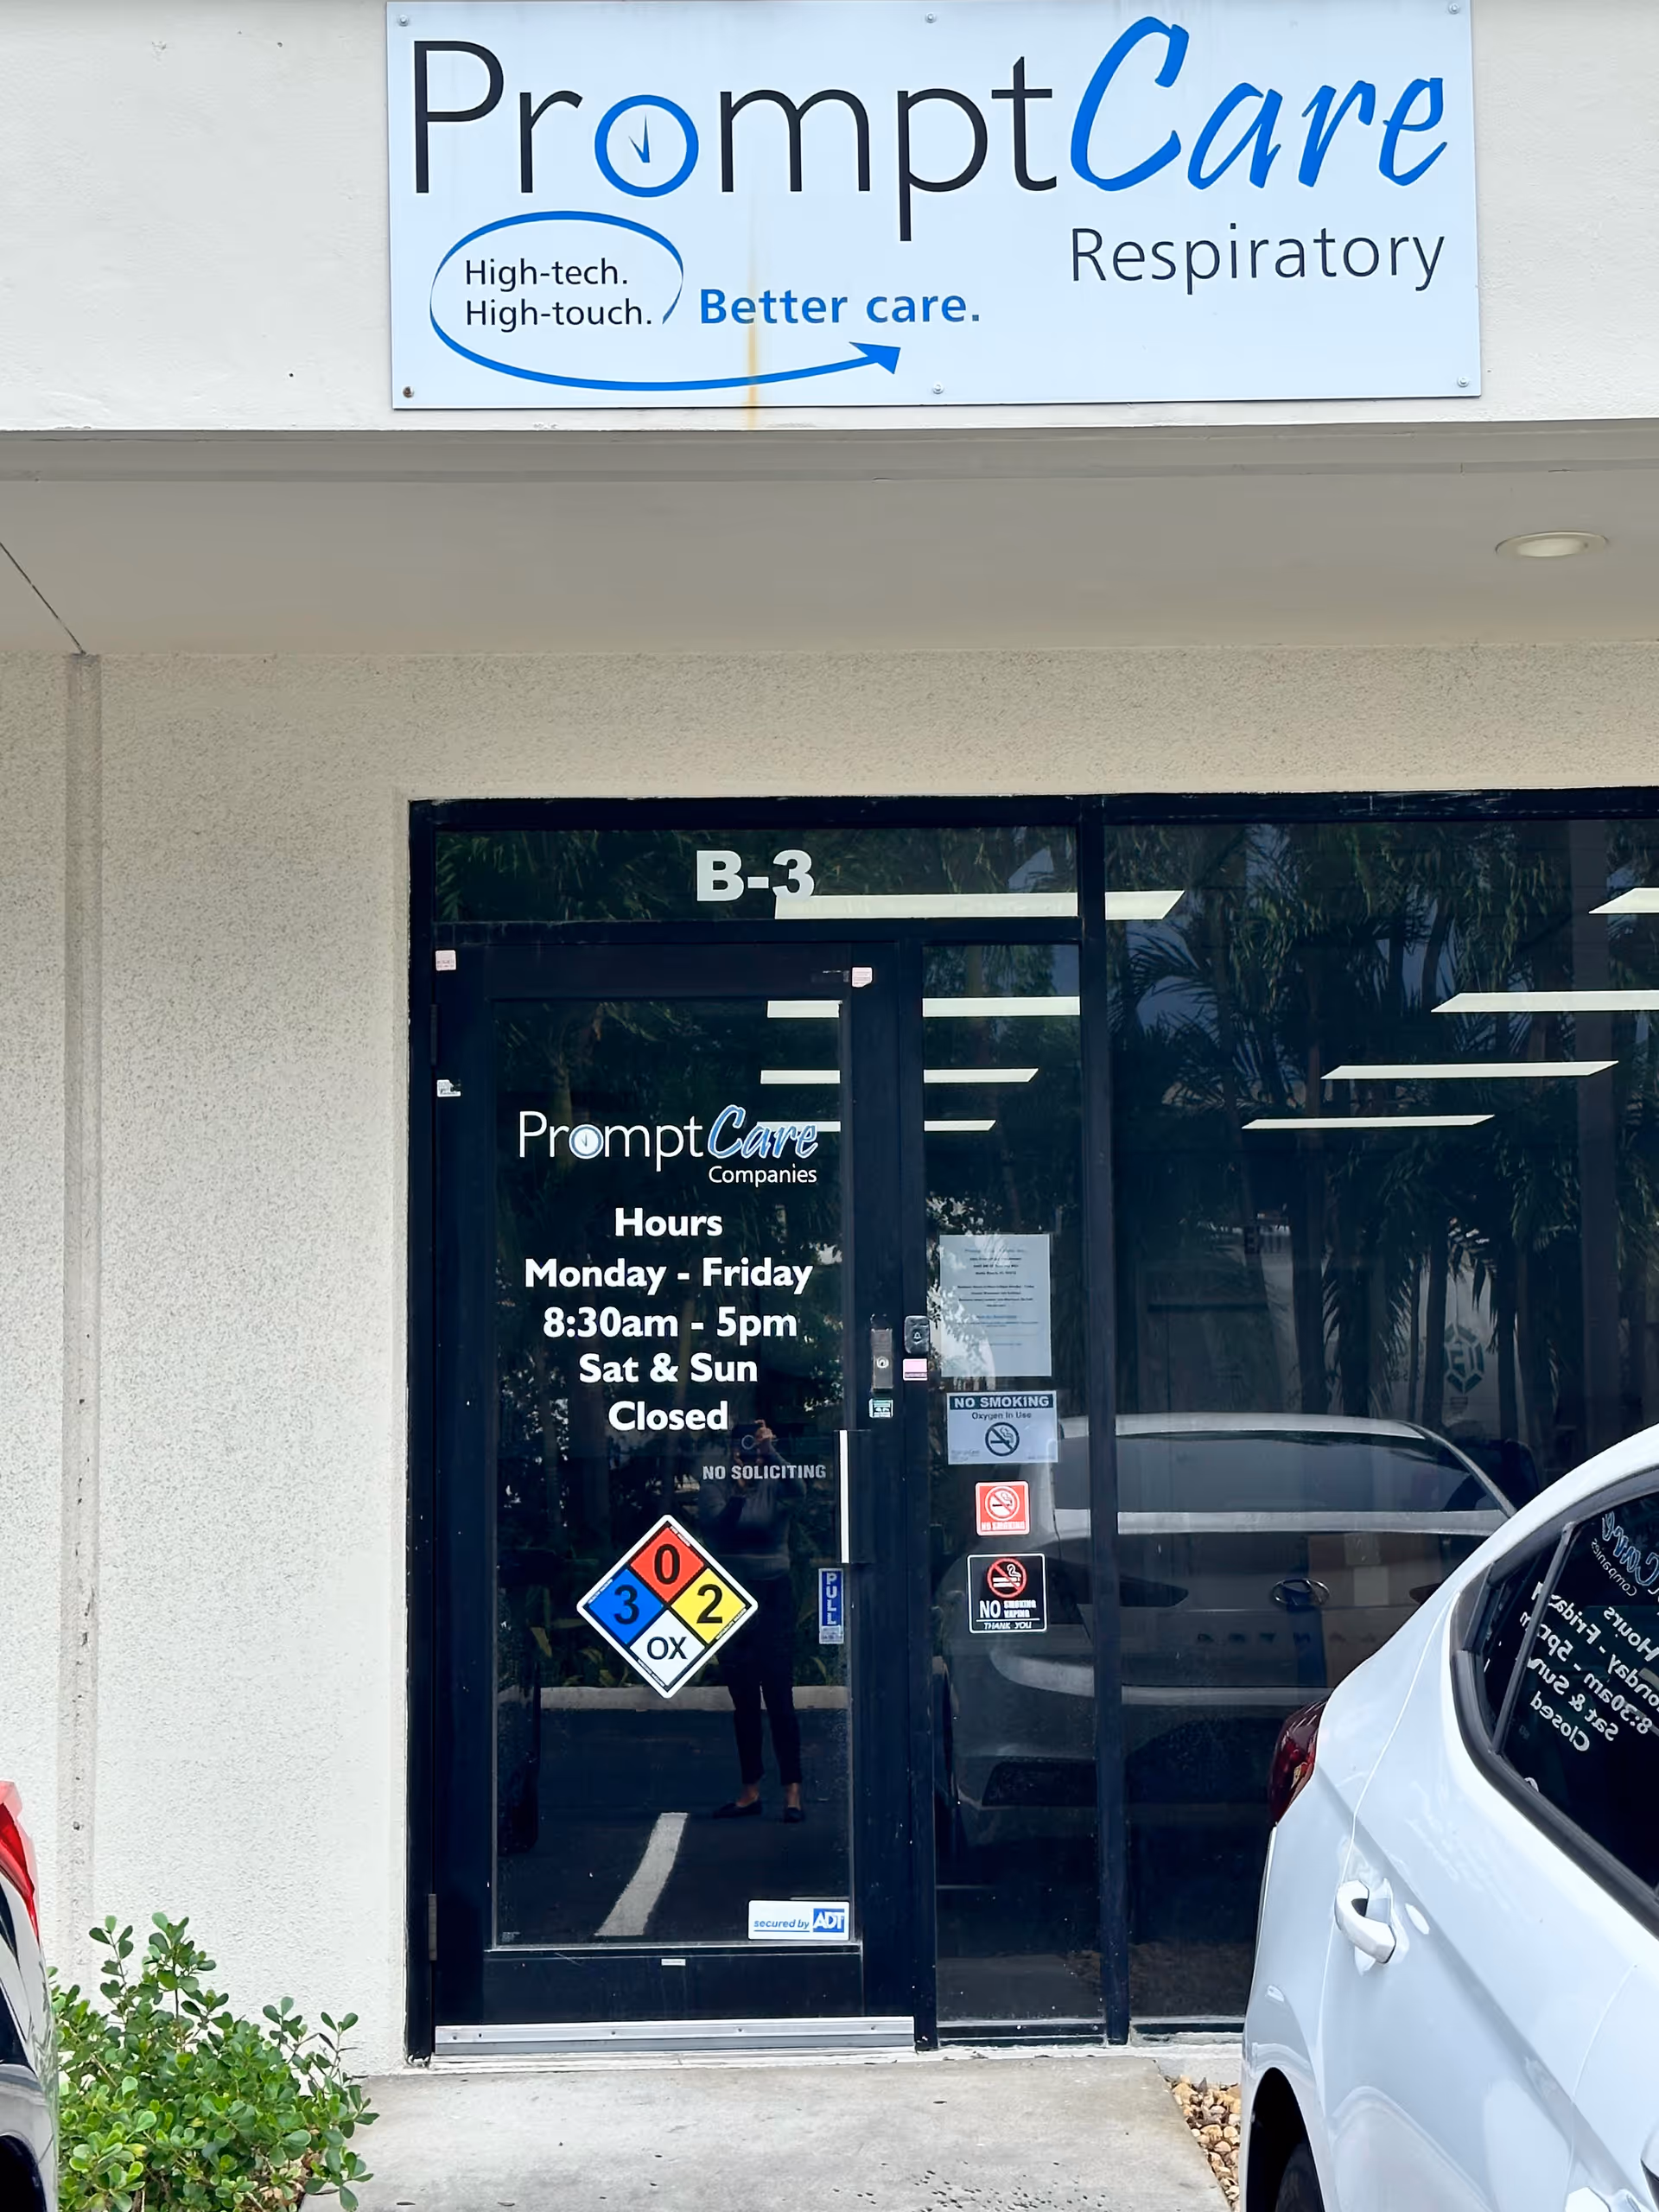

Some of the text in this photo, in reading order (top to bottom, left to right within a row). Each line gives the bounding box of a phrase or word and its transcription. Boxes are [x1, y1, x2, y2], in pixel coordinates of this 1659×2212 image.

[1071, 222, 1446, 296] Respiratory
[465, 259, 629, 293] High-tech.
[466, 299, 653, 333] High-touch.
[701, 289, 980, 325] Better care.
[696, 849, 815, 901] B-3
[708, 1165, 817, 1187] Companies
[614, 1207, 723, 1236] Hours
[524, 1256, 813, 1295] Monday - Friday
[543, 1306, 797, 1345] 8:30am - 5pm
[579, 1352, 758, 1382] Sat & Sun
[607, 1400, 728, 1431] Closed
[954, 1395, 1050, 1408] NO SMOKING
[971, 1411, 1003, 1421] Oxygen
[1015, 1410, 1033, 1419] Use
[702, 1464, 827, 1480] NO SOLICITING
[653, 1543, 681, 1585] 0
[613, 1585, 640, 1625] 3
[696, 1583, 724, 1624] 2
[825, 1572, 838, 1625] PULL
[979, 1599, 1001, 1619] NO
[983, 1620, 1033, 1630] THANK YOU
[646, 1636, 689, 1661] OX
[753, 1910, 845, 1930] secured by ADT
